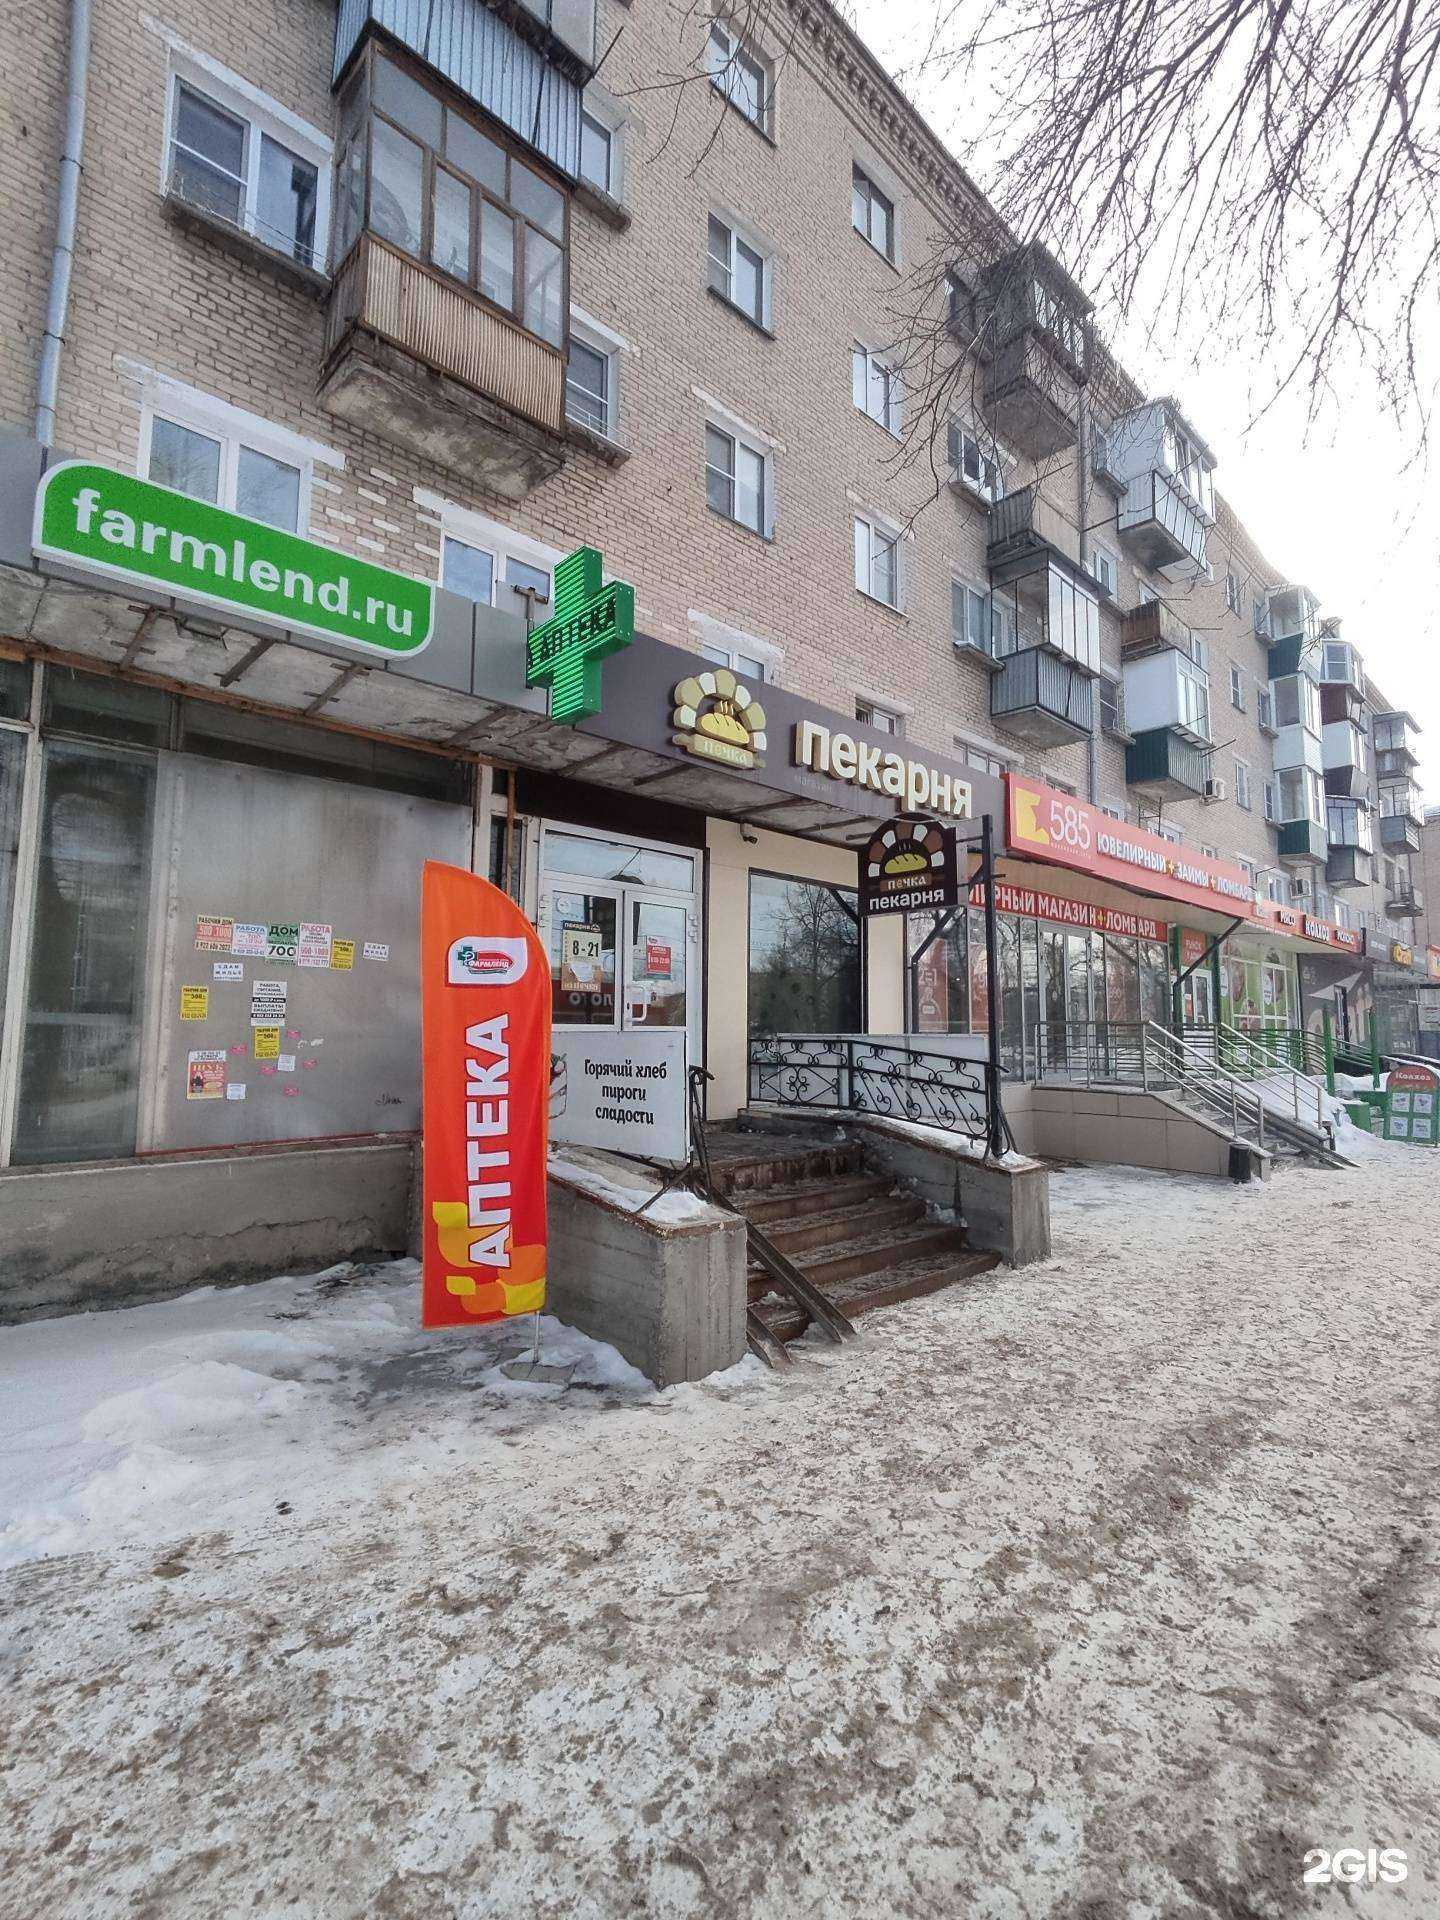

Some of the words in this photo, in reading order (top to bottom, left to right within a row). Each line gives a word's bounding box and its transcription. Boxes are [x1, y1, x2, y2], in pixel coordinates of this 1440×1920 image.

[72, 488, 413, 637] farmlend.ru
[540, 593, 616, 661] АПТЕКА
[797, 720, 972, 818] пекарня
[1050, 800, 1091, 850] 585
[1096, 831, 1167, 874] ЮВЕЛИРНЫЙ
[869, 888, 945, 911] пекарня
[887, 875, 927, 891] печка
[269, 925, 298, 936] ДОМ
[301, 924, 331, 933] РАБОТА
[1038, 894, 1096, 926] МАГАЗИН
[1106, 911, 1156, 938] ЛОМБАРД
[584, 1058, 633, 1079] Горячий
[636, 1061, 668, 1079] хлеб
[602, 1085, 647, 1103] пироги
[595, 1106, 655, 1125] сладости
[466, 1012, 512, 1269] АПТЕКА
